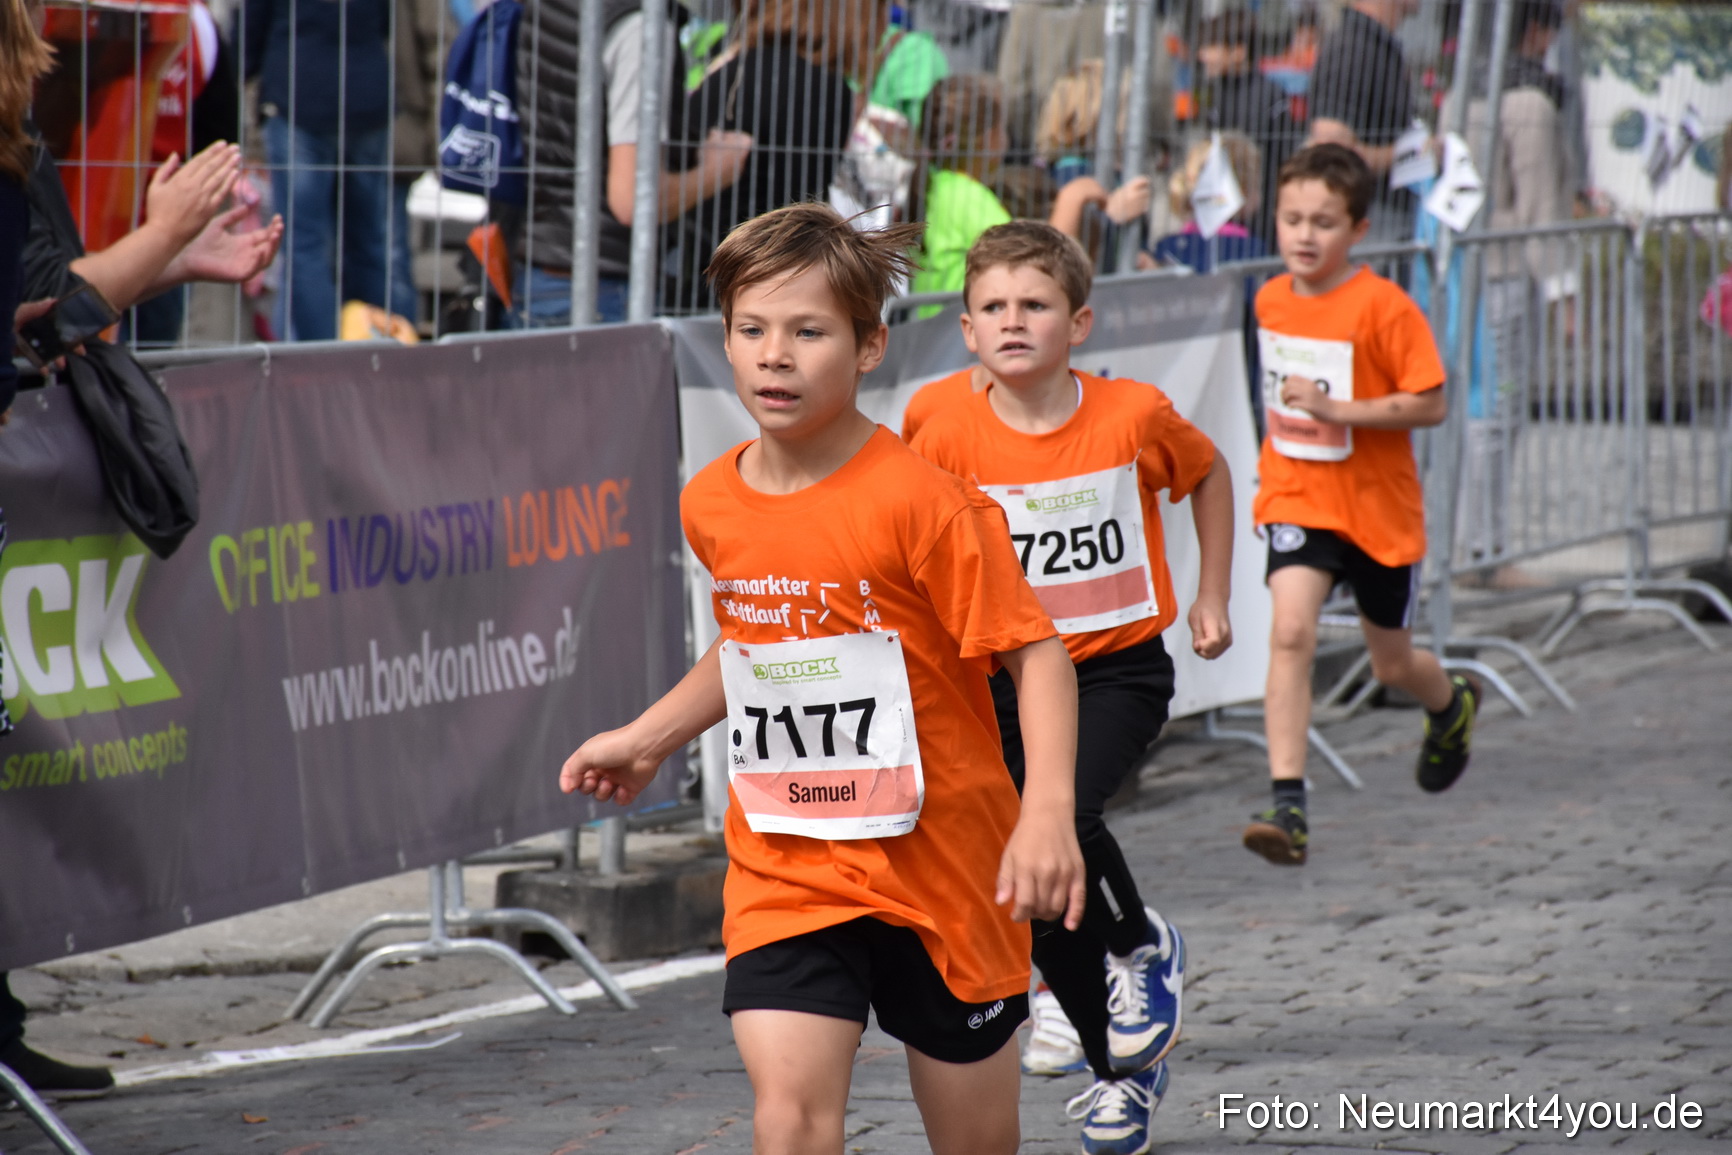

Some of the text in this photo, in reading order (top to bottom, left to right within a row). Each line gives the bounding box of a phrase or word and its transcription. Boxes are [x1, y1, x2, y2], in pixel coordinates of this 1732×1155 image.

[1041, 489, 1098, 510] BOCK
[327, 499, 495, 594] INDUSTRY
[1010, 518, 1124, 577] 7250
[0, 553, 157, 698] CK
[721, 599, 791, 628] Stdtlauf
[768, 656, 839, 679] BOCK
[745, 697, 876, 760] 7177
[1, 721, 187, 790] smart concepts
[733, 754, 746, 765] B4
[789, 781, 856, 803] Samuel
[985, 999, 1004, 1023] JAKO
